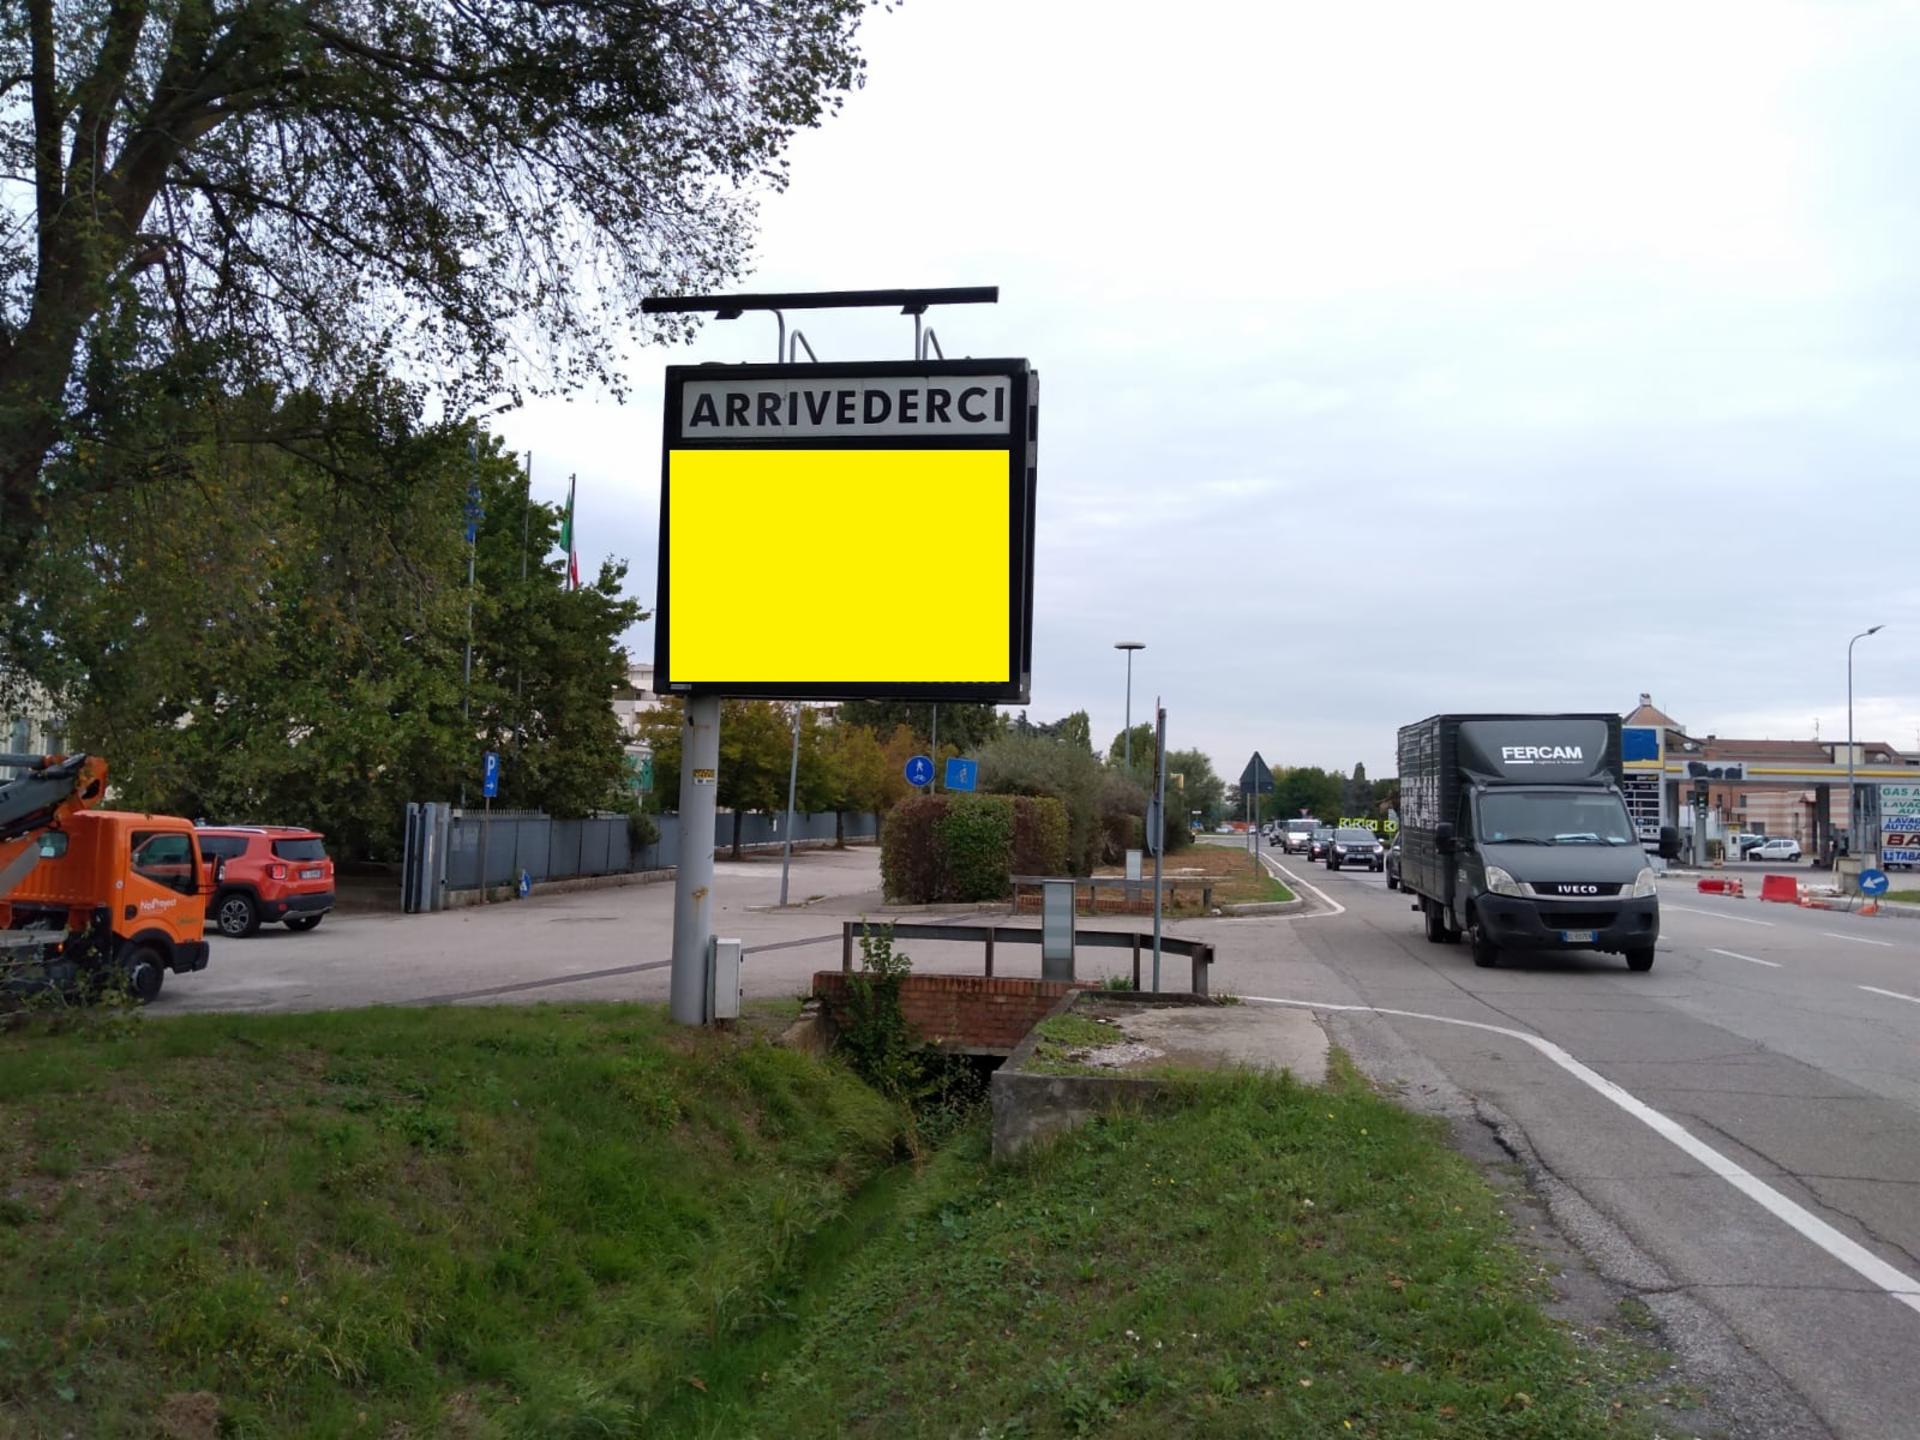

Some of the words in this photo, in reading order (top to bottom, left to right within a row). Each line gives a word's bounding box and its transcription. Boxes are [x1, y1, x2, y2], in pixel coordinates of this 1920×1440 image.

[688, 386, 1004, 427] ARRIVEDERCI
[1501, 746, 1583, 759] FERCAM
[487, 755, 495, 772] P
[1883, 788, 1908, 796] GAS
[1558, 885, 1597, 893] IVECO
